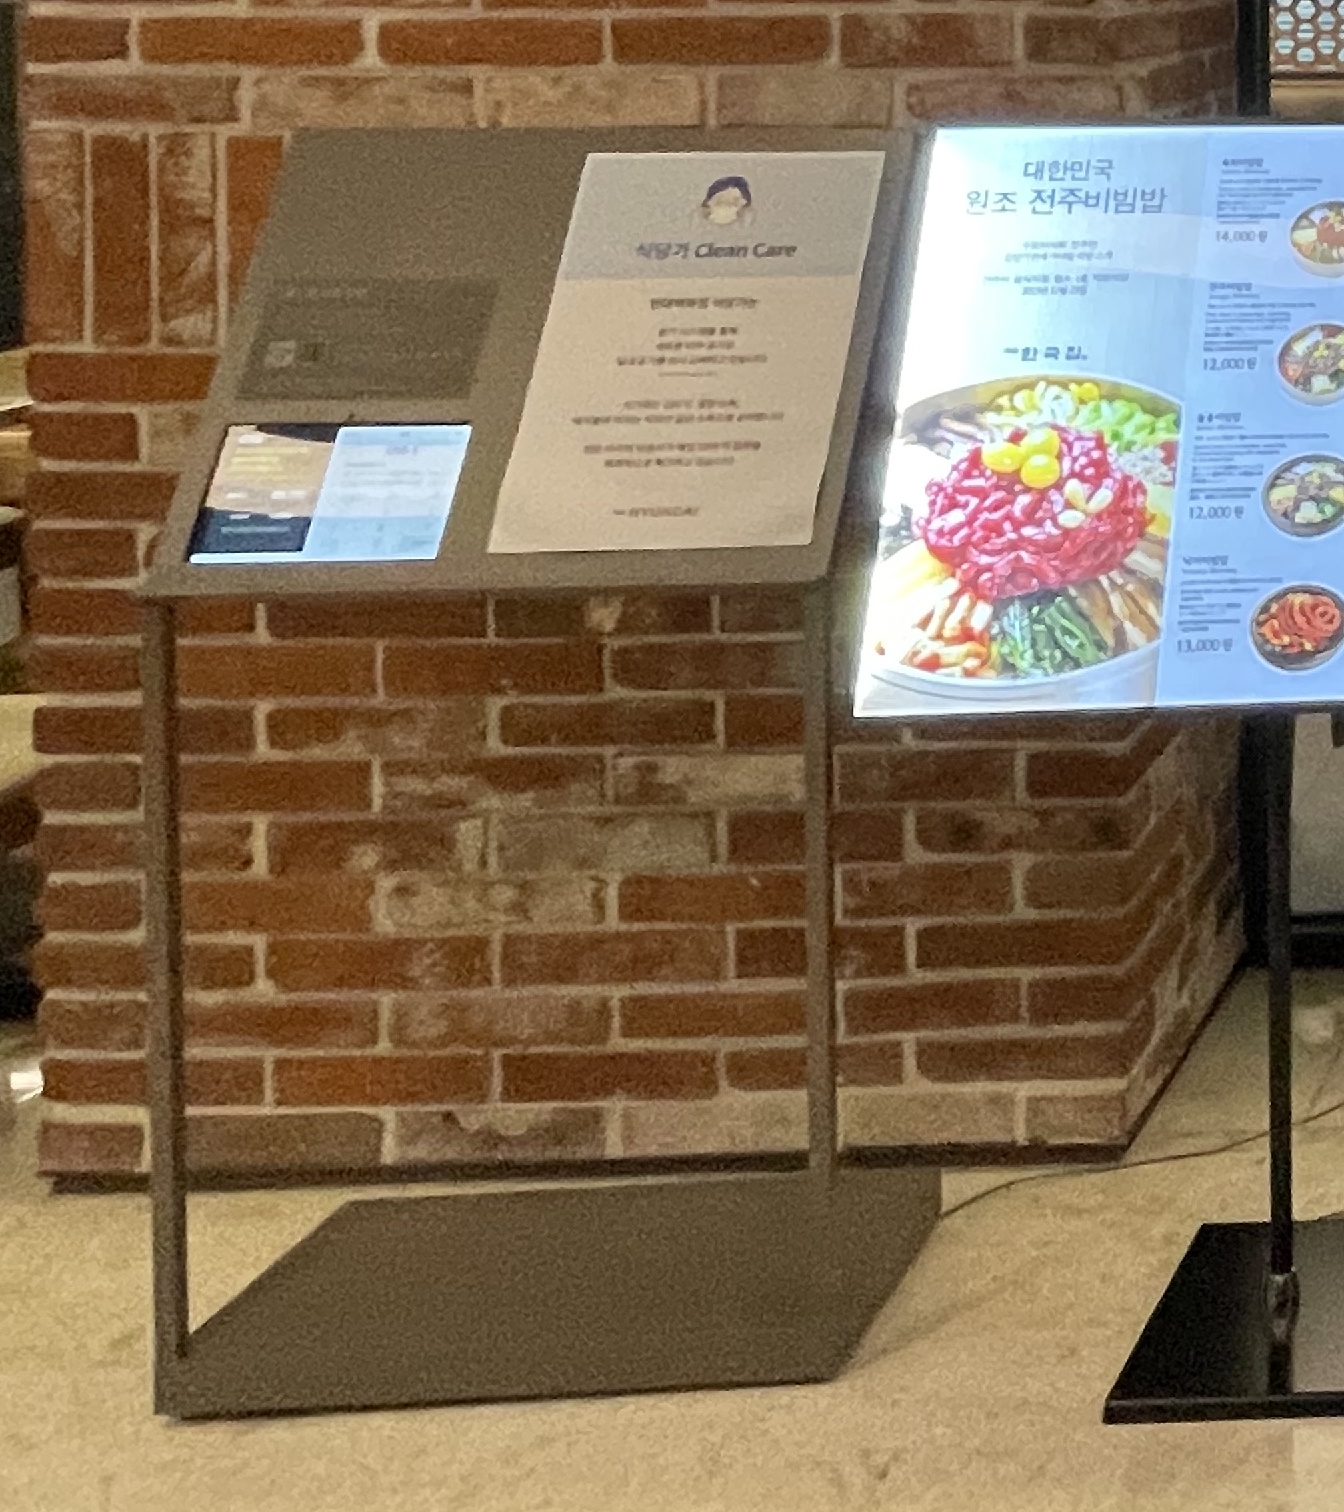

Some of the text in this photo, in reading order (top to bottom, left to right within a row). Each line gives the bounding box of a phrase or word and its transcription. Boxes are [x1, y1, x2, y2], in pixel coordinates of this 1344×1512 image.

[1022, 158, 1114, 181] 대한민국
[1028, 187, 1168, 216] 전주비빔밥
[695, 243, 748, 259] Clean
[752, 242, 798, 258] Care
